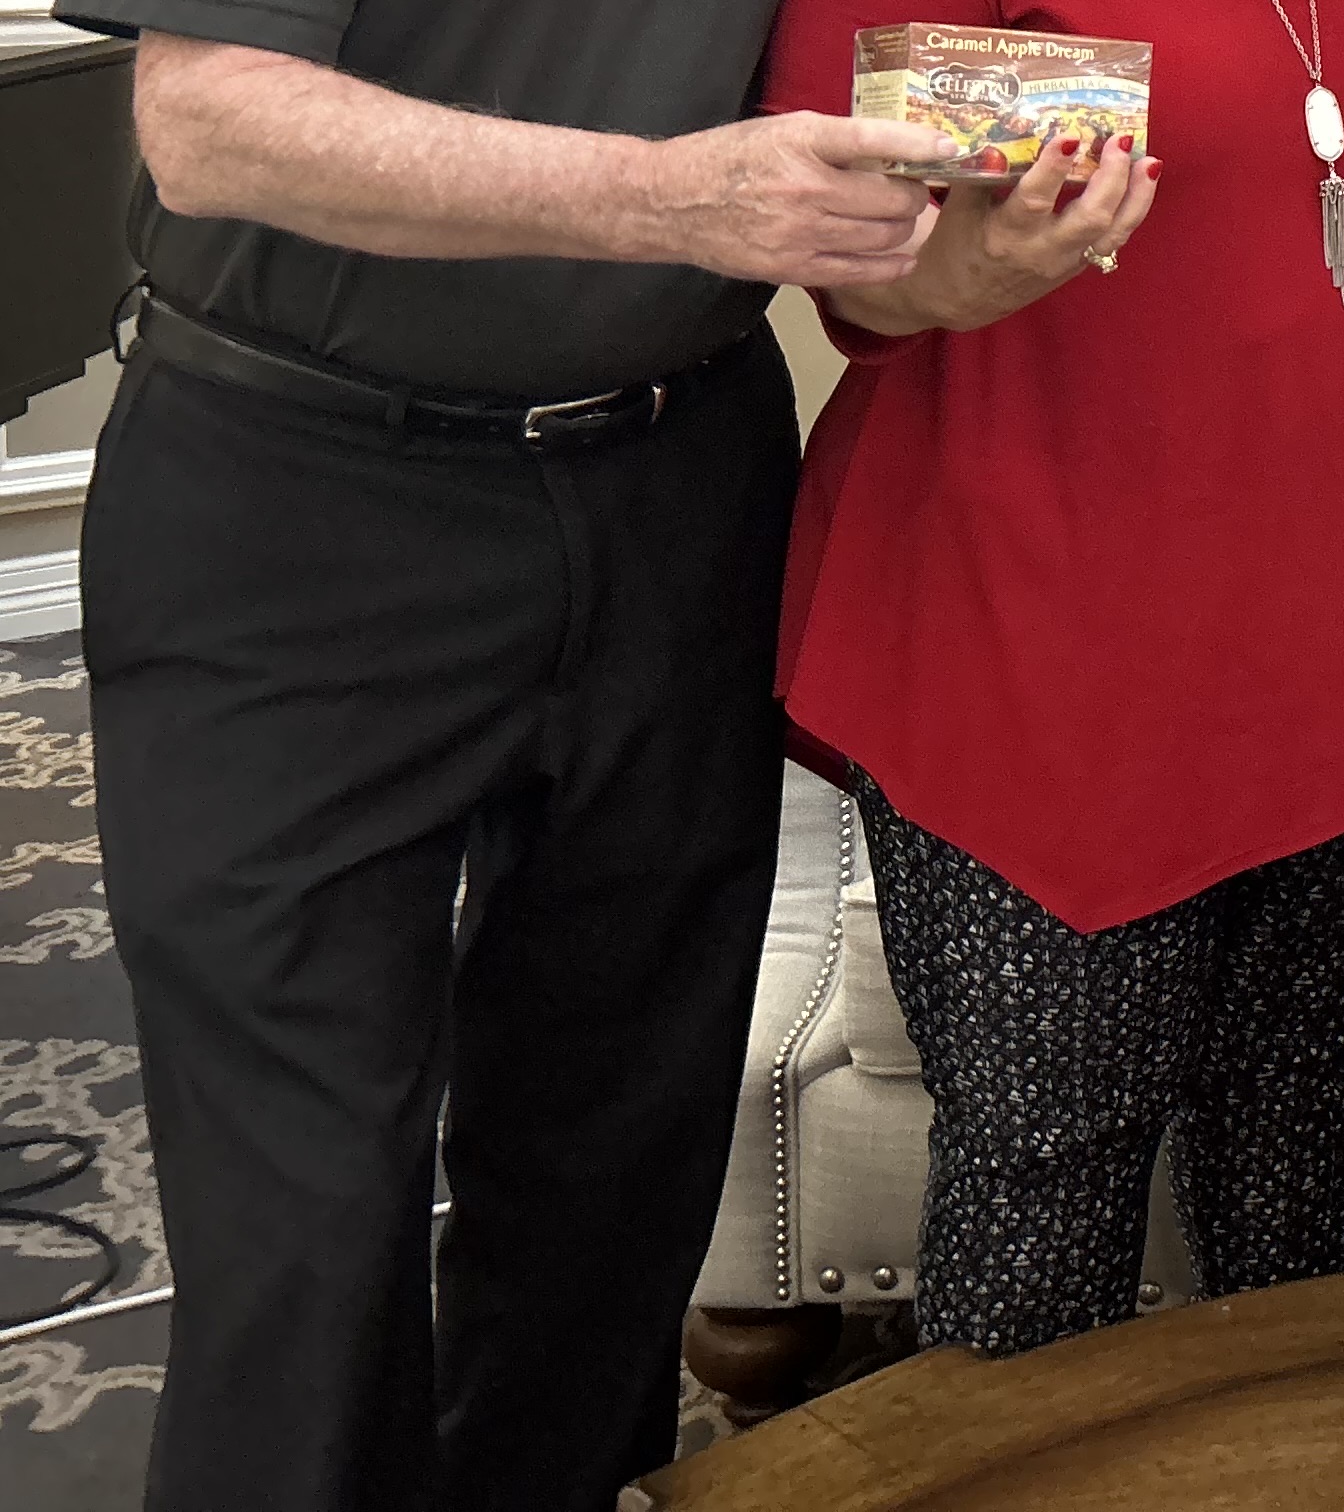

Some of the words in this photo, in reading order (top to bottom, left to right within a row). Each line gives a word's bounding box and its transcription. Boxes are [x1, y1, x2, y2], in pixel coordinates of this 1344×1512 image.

[926, 32, 992, 53] Caramel
[996, 38, 1042, 59] Apple
[1046, 42, 1095, 60] Dream
[1029, 80, 1069, 94] HERBAL
